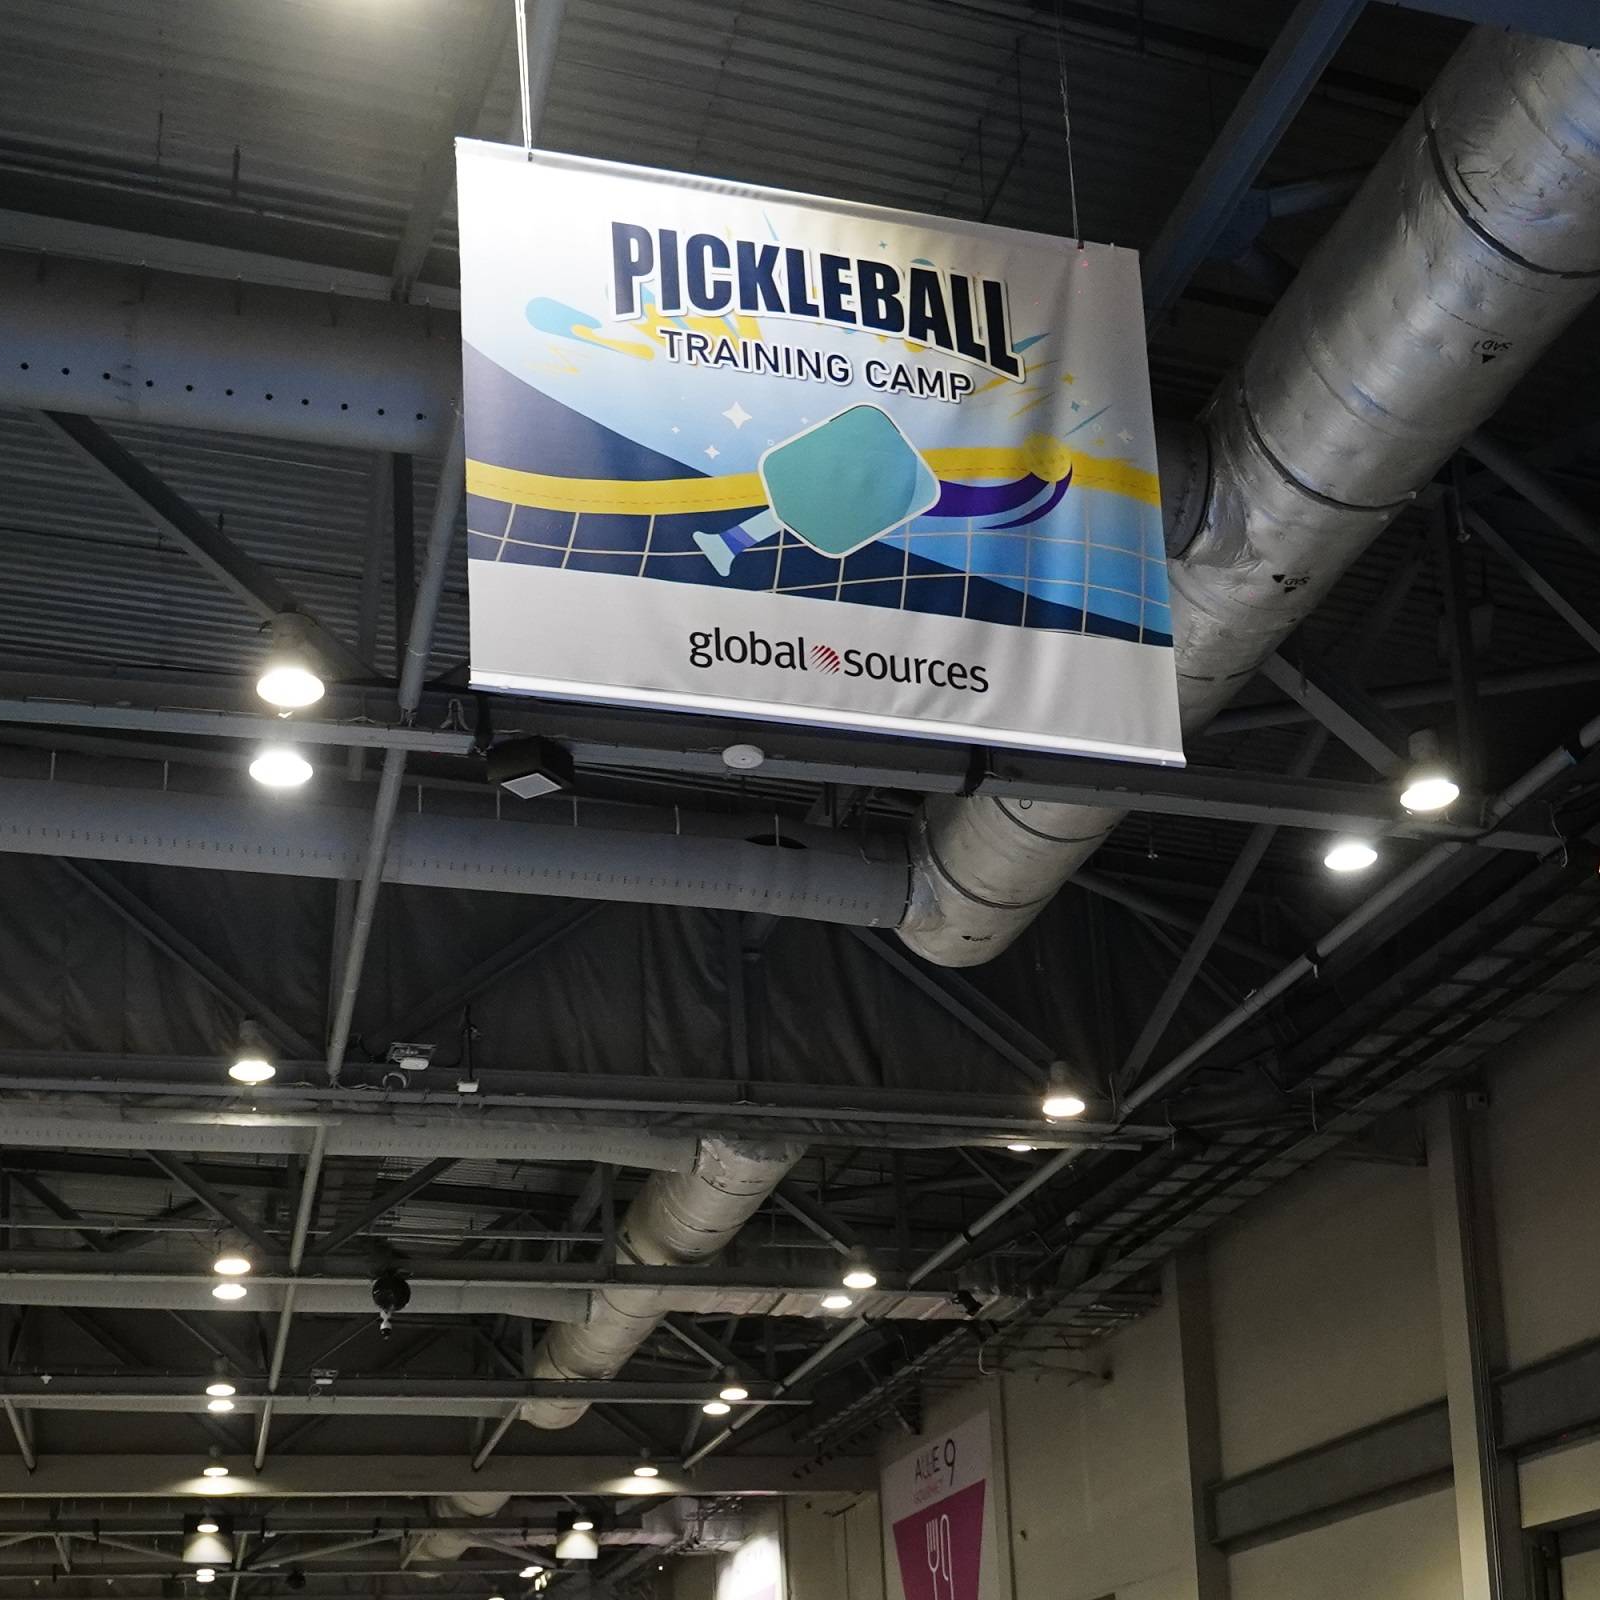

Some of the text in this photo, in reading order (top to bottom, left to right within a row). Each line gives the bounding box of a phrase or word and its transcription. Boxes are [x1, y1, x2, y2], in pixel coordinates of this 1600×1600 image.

[611, 221, 1023, 378] PICKLEBALL
[660, 330, 972, 402] TRAINING CAMP
[689, 627, 989, 693] global sources
